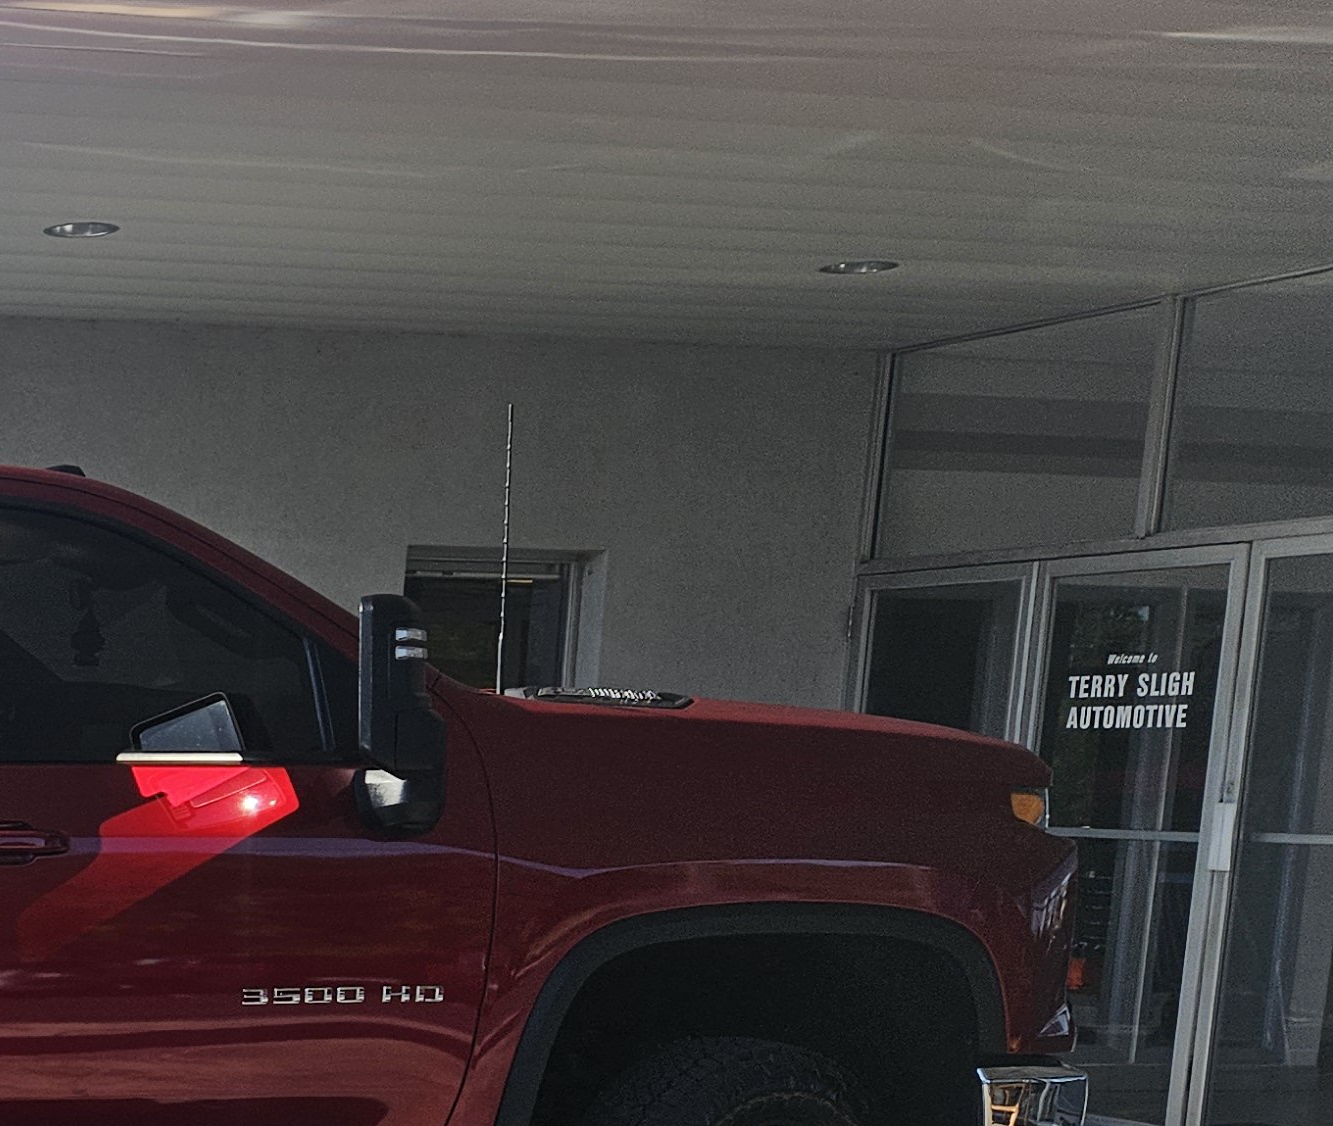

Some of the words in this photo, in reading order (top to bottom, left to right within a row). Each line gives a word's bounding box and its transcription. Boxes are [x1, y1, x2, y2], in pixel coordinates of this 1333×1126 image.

[1107, 653, 1146, 665] Welcome
[1148, 652, 1158, 663] to
[1068, 673, 1129, 698] TERRY
[1136, 671, 1195, 697] SLIGH
[1066, 704, 1188, 729] AUTOMOTIVE
[242, 986, 365, 1005] 3500
[382, 985, 444, 1003] HD
